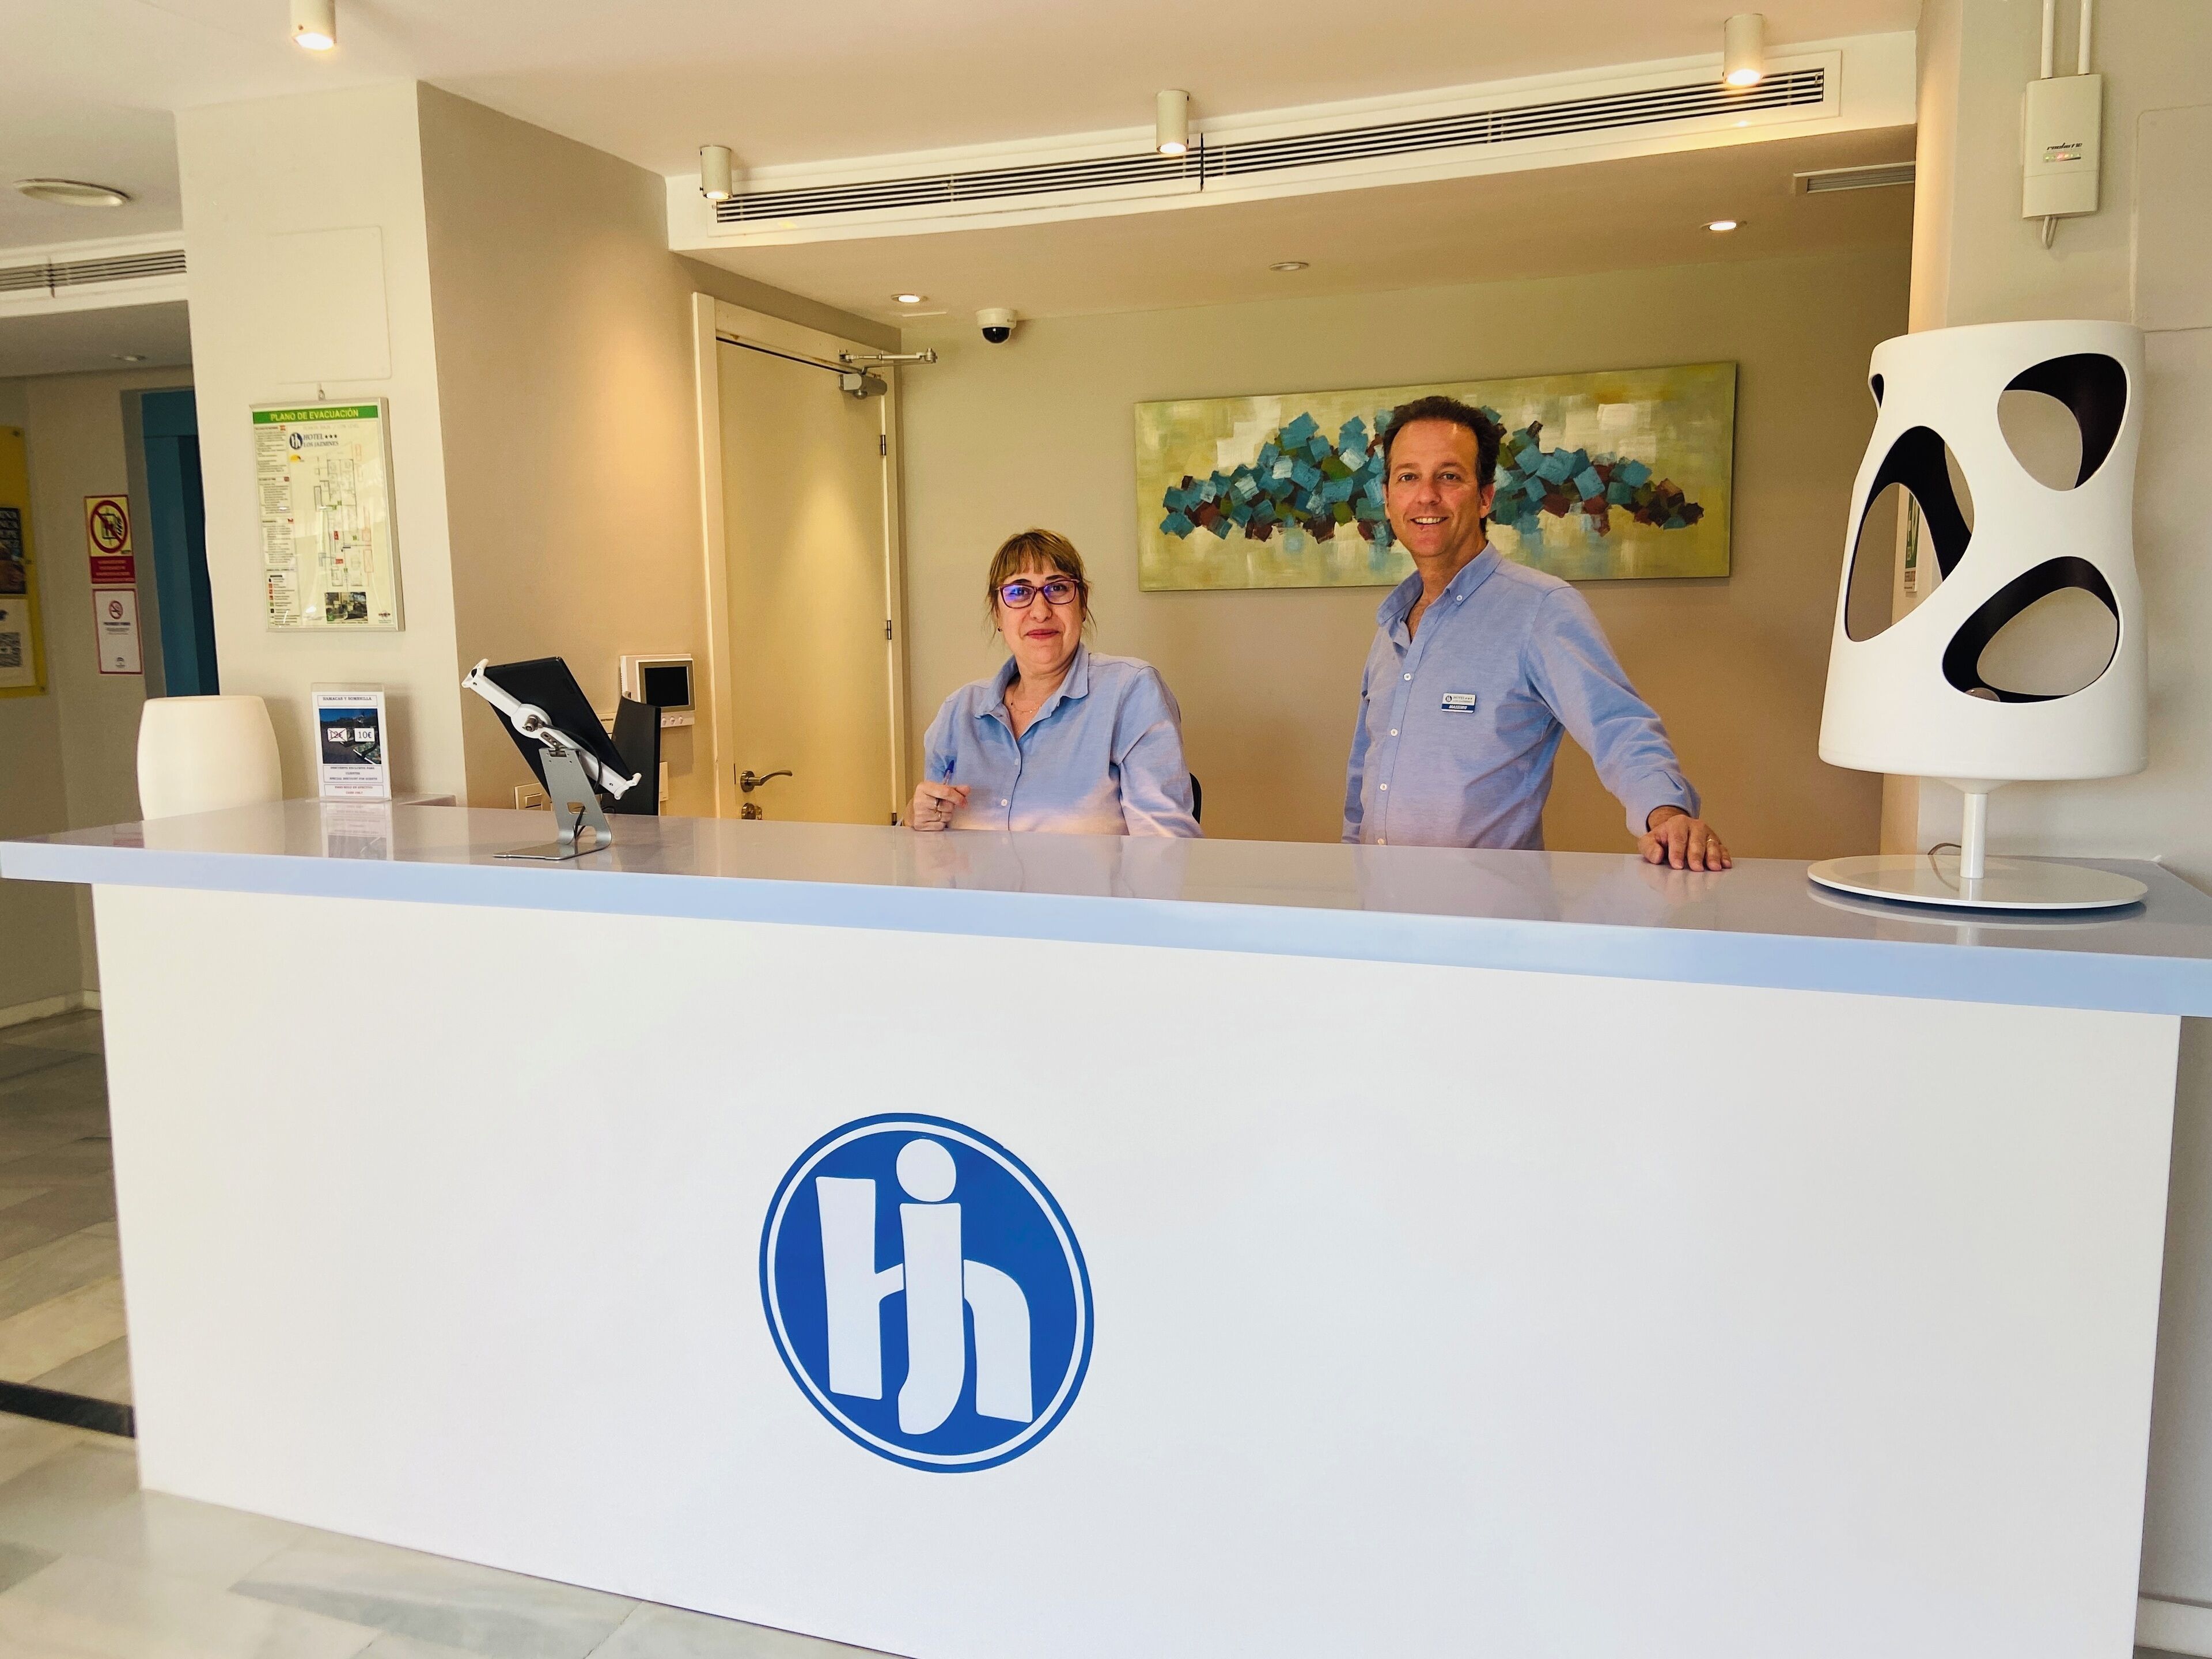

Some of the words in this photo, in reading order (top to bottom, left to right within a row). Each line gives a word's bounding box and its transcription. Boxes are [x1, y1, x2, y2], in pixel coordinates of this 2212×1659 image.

[270, 413, 296, 421] PLANO
[297, 411, 308, 420] DE
[309, 408, 359, 419] EVACUACIÓN
